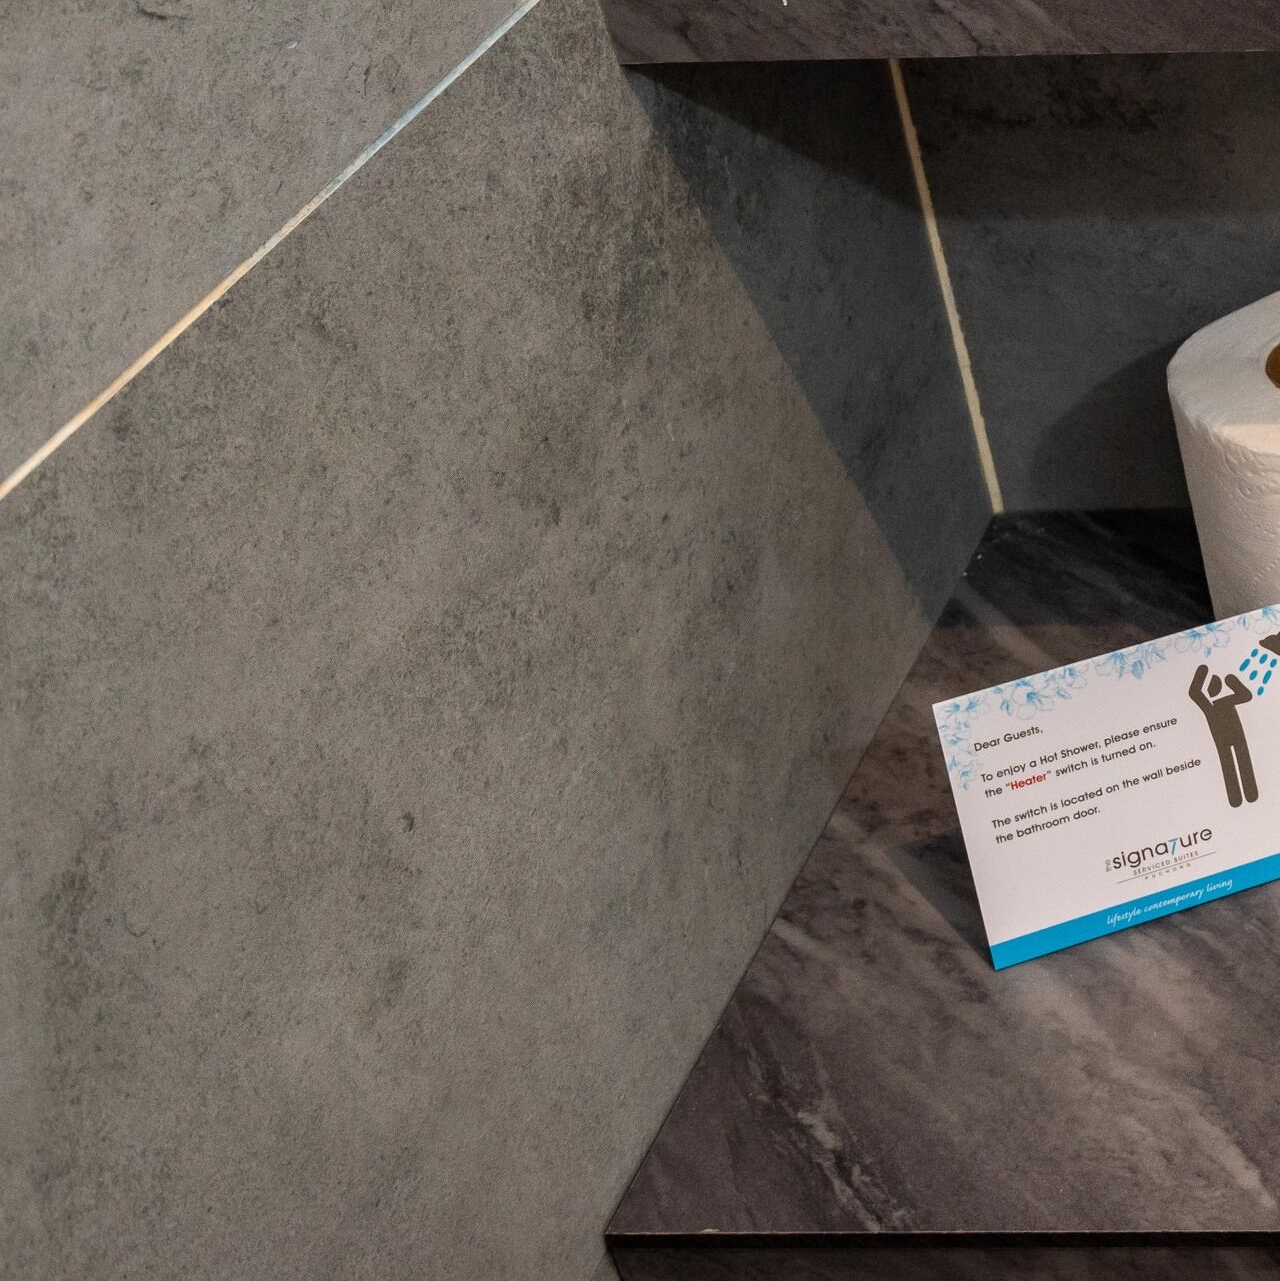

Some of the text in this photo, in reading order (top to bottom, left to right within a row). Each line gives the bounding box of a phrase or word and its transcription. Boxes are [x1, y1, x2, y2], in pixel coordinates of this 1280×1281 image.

[973, 726, 1043, 752] Dear Guests,
[980, 718, 1178, 783] To enjoy a Hot Shower, please ensure
[984, 787, 1003, 798] the
[1055, 760, 1089, 777] switch
[1090, 757, 1099, 766] is
[1101, 744, 1137, 763] turned
[1138, 741, 1156, 751] on.
[991, 759, 1201, 829] The switch is located on the wall beside
[995, 806, 1101, 844] the bathroom door.
[1133, 850, 1199, 876] SERVICED SUITES
[1107, 879, 1233, 925] lifestyle contemporary living
